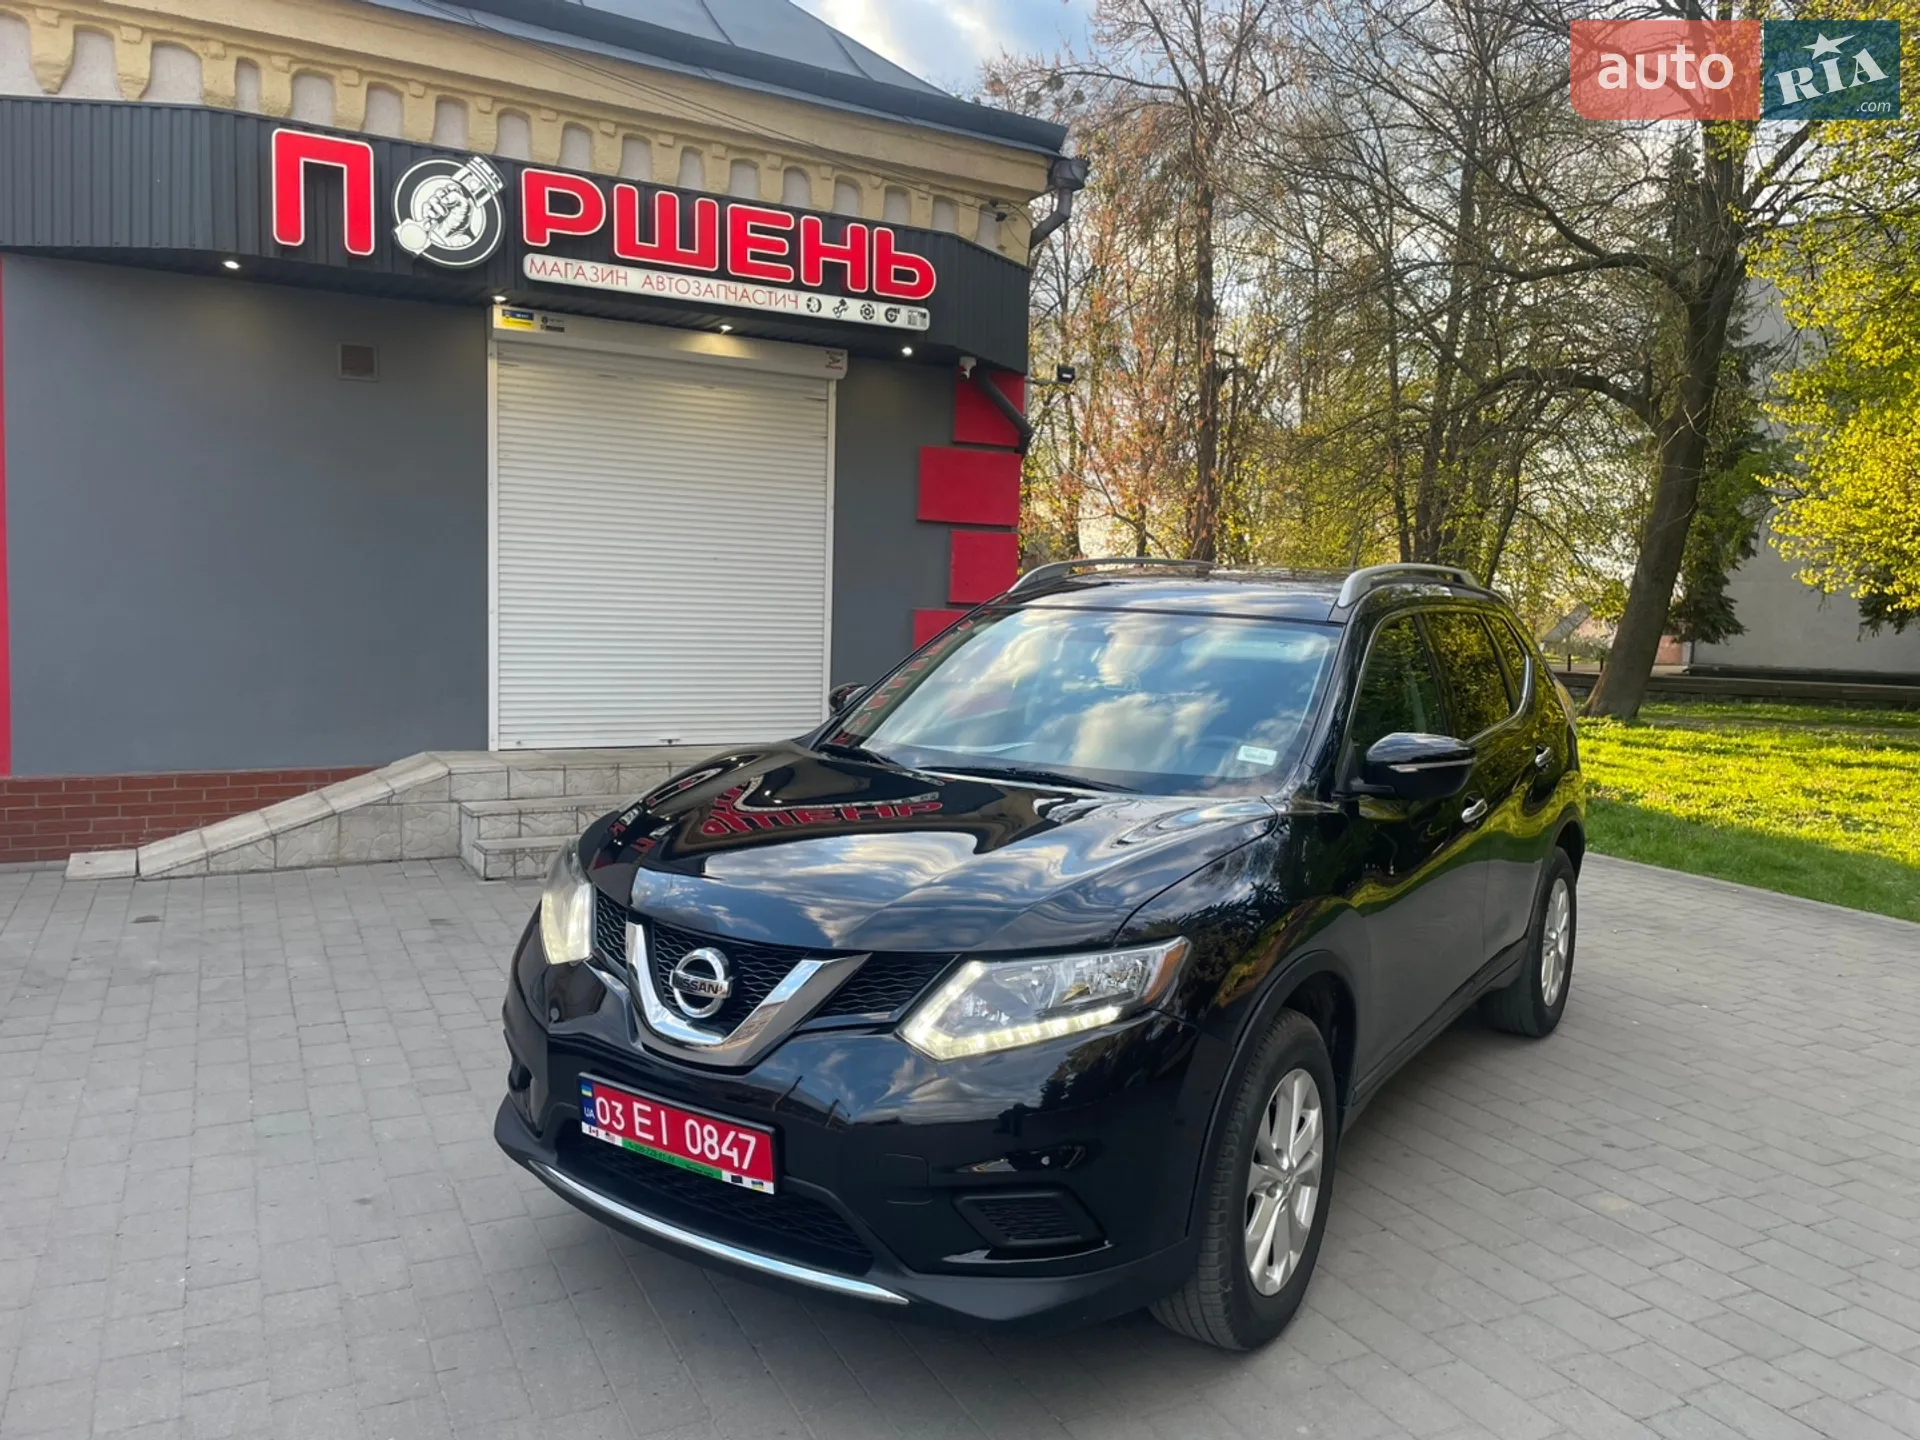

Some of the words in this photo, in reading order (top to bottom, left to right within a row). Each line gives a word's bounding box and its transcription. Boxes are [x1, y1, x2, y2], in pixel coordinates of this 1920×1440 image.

[529, 258, 628, 287] МАГАЗИН
[584, 1106, 595, 1120] UA
[595, 1096, 626, 1131] 03
[632, 1101, 668, 1146] EI
[684, 1118, 757, 1170] 0847
